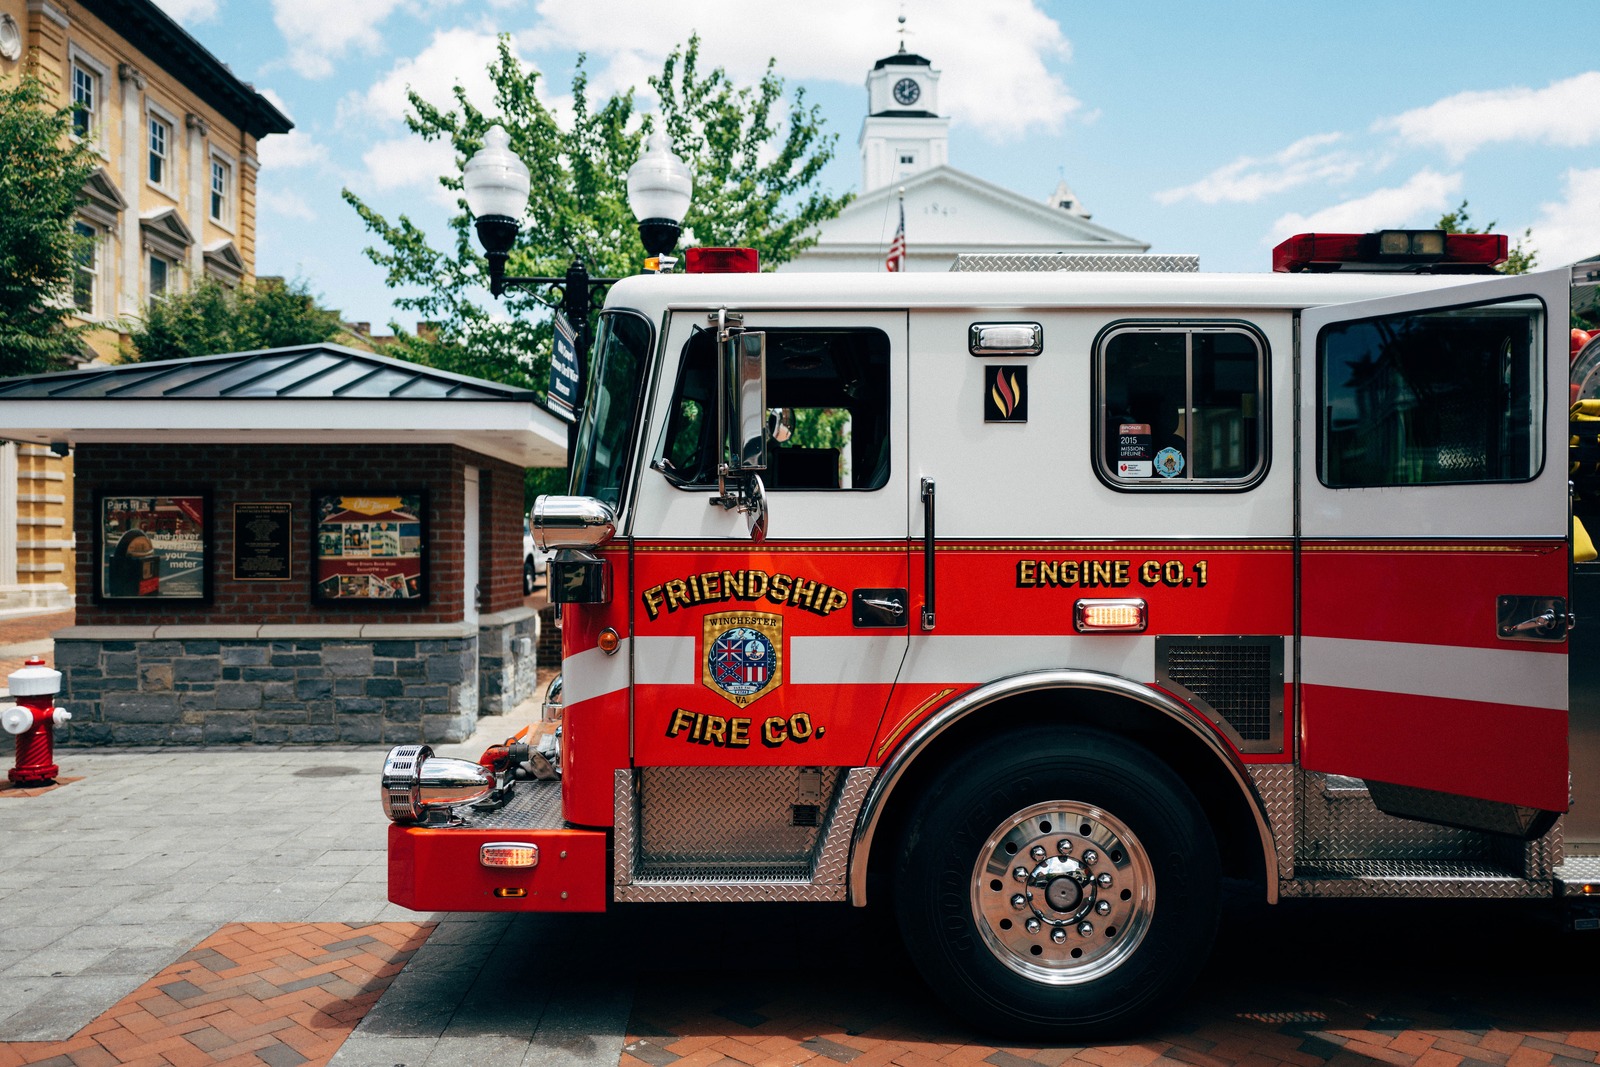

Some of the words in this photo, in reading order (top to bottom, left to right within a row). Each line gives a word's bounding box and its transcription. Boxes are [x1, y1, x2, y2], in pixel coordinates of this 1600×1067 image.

[1120, 436, 1138, 445] 2015
[107, 501, 128, 510] Park
[153, 532, 171, 541] and
[172, 533, 200, 541] never
[165, 552, 187, 561] your
[1016, 560, 1130, 588] ENGINE
[642, 569, 848, 622] FRIENDSHIP
[709, 616, 777, 627] WINCHESTER
[735, 696, 749, 704] VA.
[665, 708, 751, 748] FIRE
[761, 712, 826, 748] CO.
